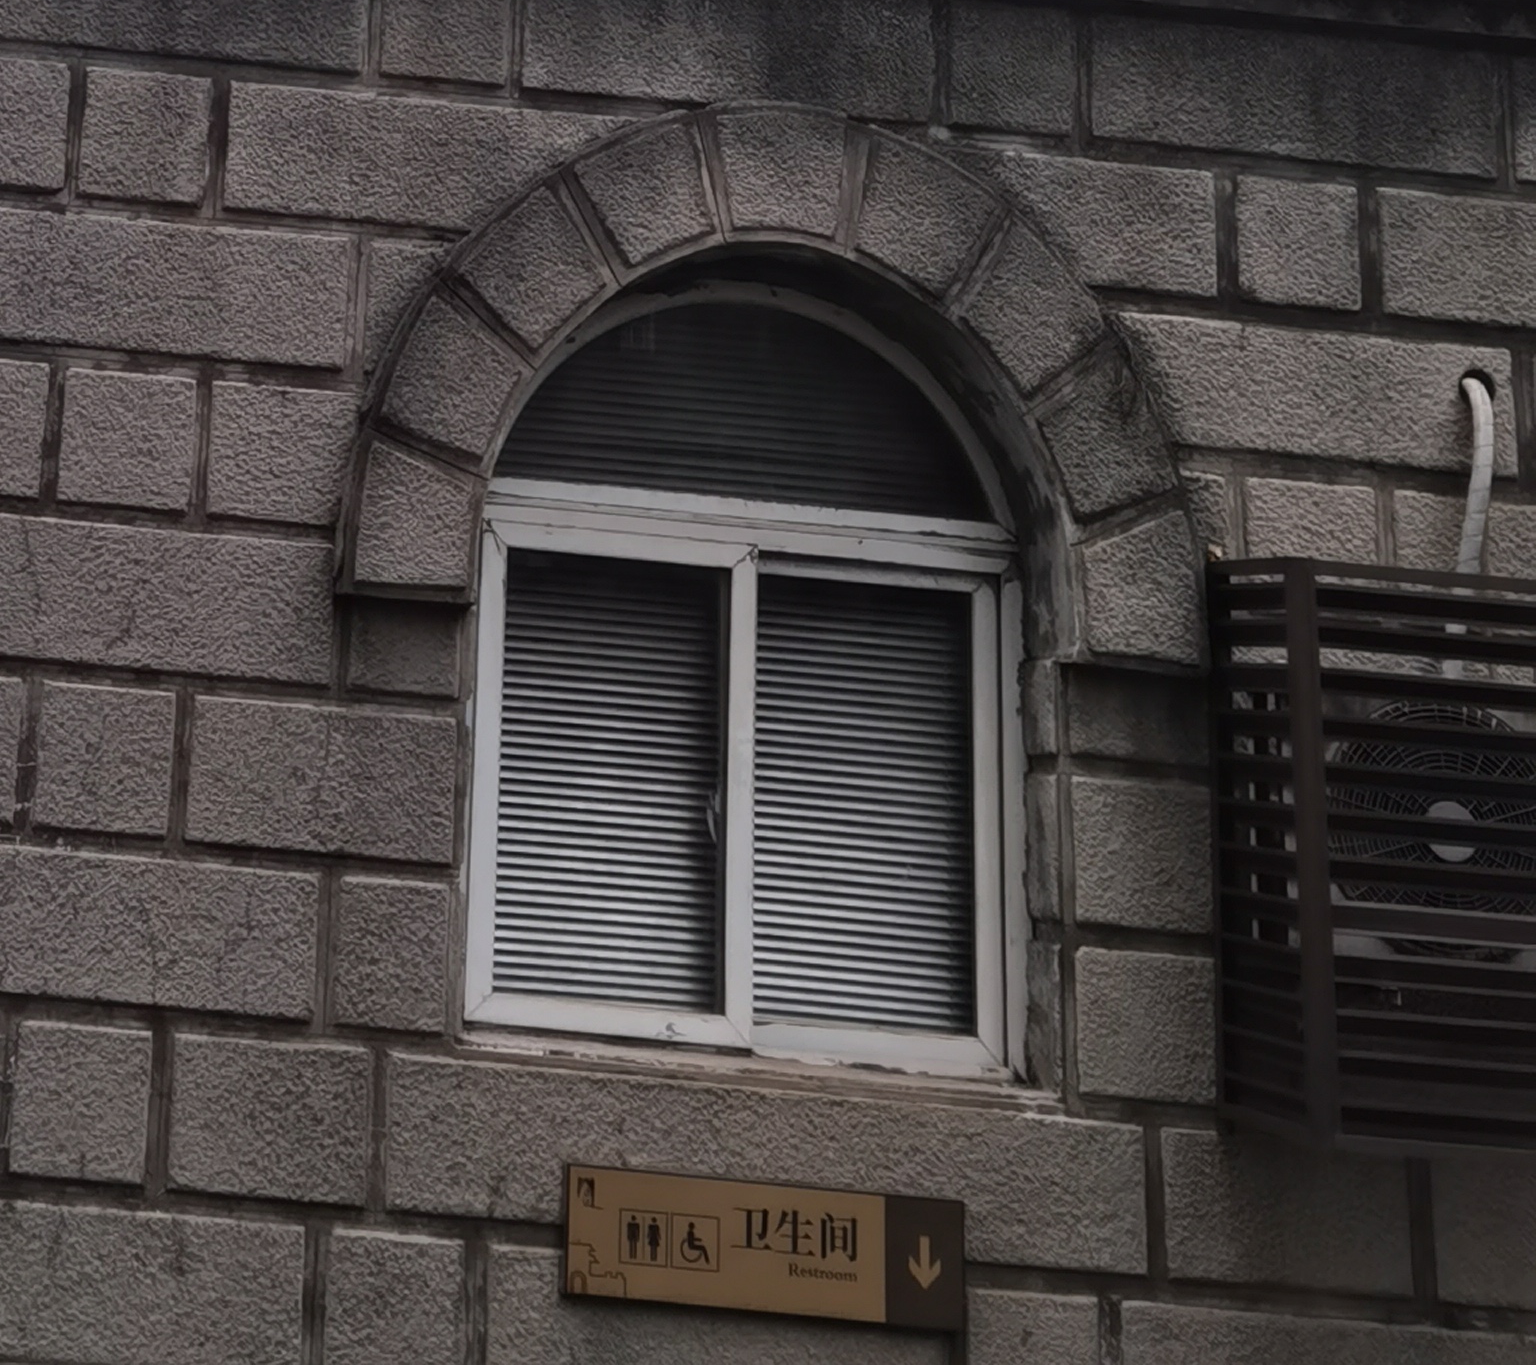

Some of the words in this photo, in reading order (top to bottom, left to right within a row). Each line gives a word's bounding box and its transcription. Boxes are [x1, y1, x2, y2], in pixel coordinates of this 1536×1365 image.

[730, 1207, 858, 1262] 卫生间
[788, 1262, 858, 1282] Restroom
